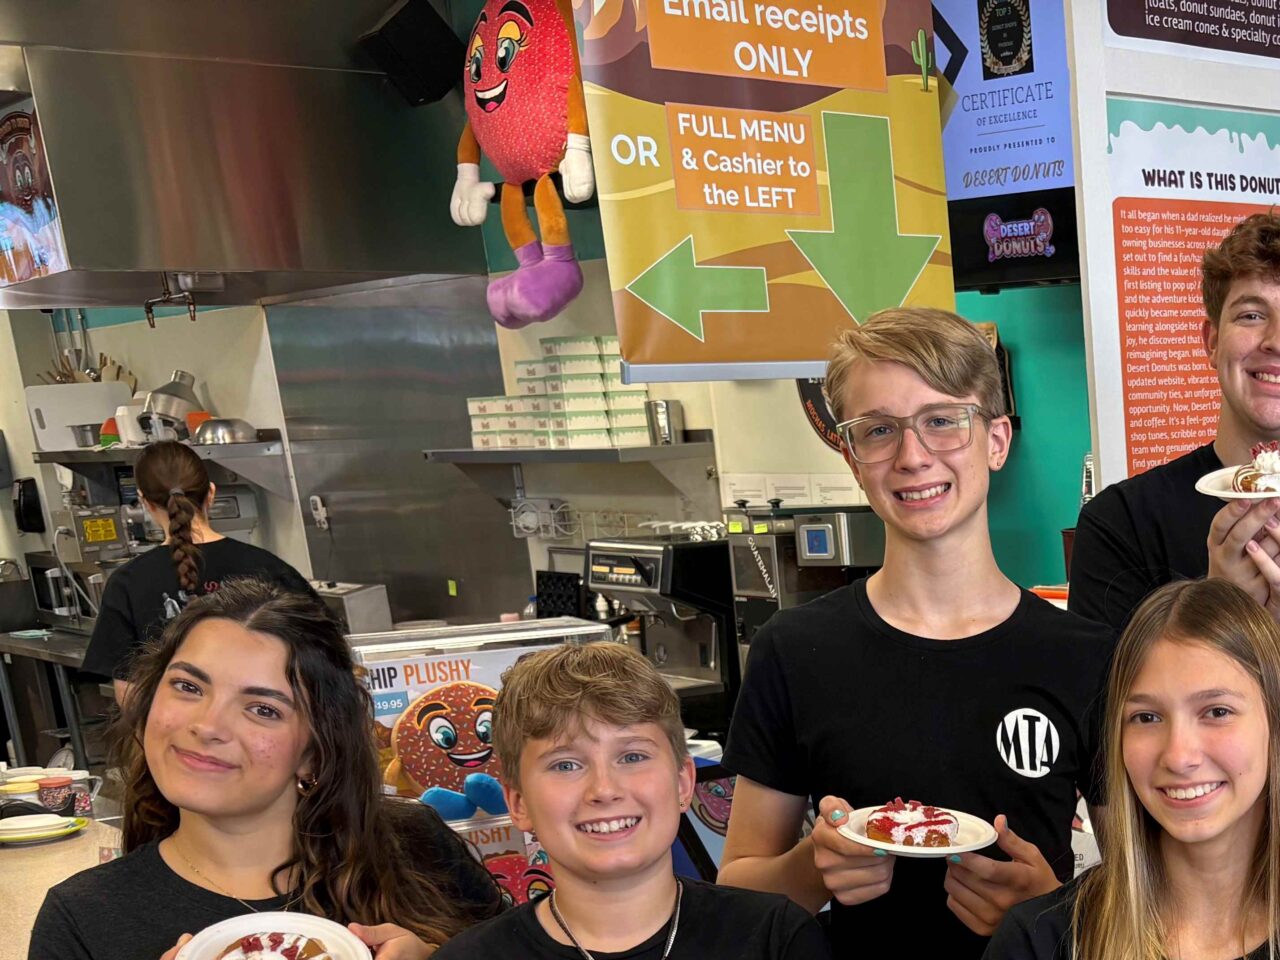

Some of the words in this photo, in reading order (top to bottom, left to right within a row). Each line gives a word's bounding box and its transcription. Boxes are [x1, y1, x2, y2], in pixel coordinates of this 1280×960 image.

[1180, 0, 1208, 15] donut
[1210, 5, 1248, 24] sundaes,
[1250, 11, 1276, 25] donut
[664, 0, 748, 25] Email
[755, 2, 869, 42] receipts
[1146, 11, 1160, 26] ice
[1163, 17, 1192, 31] cream
[1195, 20, 1219, 36] cones
[1222, 24, 1230, 37] &
[1231, 26, 1270, 46] specialty
[734, 41, 813, 77] ONLY
[962, 82, 1053, 112] CERTIFICATE
[976, 117, 987, 126] OF
[988, 109, 1038, 125] EXCELLENCE
[678, 113, 736, 140] FULL
[741, 118, 806, 144] MENU
[611, 134, 660, 168] OR
[970, 144, 1000, 154] PROUDLY
[1004, 139, 1043, 150] PRESENTED
[682, 150, 699, 170] &
[704, 150, 784, 176] Cashier
[788, 155, 811, 177] to
[963, 166, 1010, 188] DESERT
[1011, 160, 1065, 181] DONUTS
[1142, 168, 1185, 189] WHAT
[1190, 171, 1203, 190] IS
[1207, 172, 1236, 191] THIS
[1240, 174, 1280, 195] DONUT
[704, 181, 740, 206] the
[745, 185, 796, 209] LEFT
[1128, 210, 1136, 220] all
[1138, 210, 1160, 222] began
[1162, 211, 1180, 220] when
[1186, 212, 1198, 221] dad
[1000, 221, 1036, 237] DESERT
[1135, 227, 1151, 235] easy
[1153, 224, 1162, 235] for
[1176, 226, 1211, 237] 11-year-old
[994, 236, 1045, 257] DONUTS
[1122, 239, 1147, 250] owning
[1148, 239, 1185, 248] businesses
[1135, 254, 1146, 262] out
[1123, 266, 1140, 276] skills
[1142, 267, 1155, 276] and
[1171, 267, 1188, 276] value
[1124, 280, 1138, 290] first
[1140, 280, 1162, 292] listing
[1172, 283, 1185, 293] pop
[1125, 294, 1137, 303] and
[1152, 294, 1187, 303] adventure
[1125, 308, 1149, 320] quickly
[1151, 308, 1178, 317] became
[1126, 322, 1153, 333] learning
[1155, 322, 1188, 333] alongside
[1126, 337, 1137, 347] joy,
[1149, 335, 1186, 345] discovered
[1187, 335, 1200, 344] that
[1127, 349, 1167, 360] reimagining
[1168, 349, 1190, 360] began.
[1127, 362, 1149, 373] Desert
[1151, 362, 1176, 372] Donuts
[1178, 364, 1191, 372] was
[1127, 377, 1156, 388] updated
[1158, 376, 1186, 386] website,
[1188, 375, 1209, 384] vibrant
[1128, 390, 1167, 402] community
[1169, 390, 1183, 399] ties,
[1129, 404, 1171, 416] opportunity.
[1173, 402, 1190, 412] Now,
[1191, 402, 1211, 410] Desert
[1130, 418, 1142, 428] and
[1144, 417, 1167, 428] coffee.
[1169, 416, 1179, 426] It's
[1186, 415, 1216, 426] feel-good
[1131, 432, 1146, 441] shop
[1148, 431, 1169, 440] tunes,
[1170, 428, 1197, 439] scribble
[1132, 446, 1148, 454] team
[1150, 444, 1164, 452] who
[403, 659, 472, 686] PLUSHY
[375, 699, 403, 710] 19.95
[997, 709, 1059, 777] MTA
[469, 826, 513, 844] USHY
